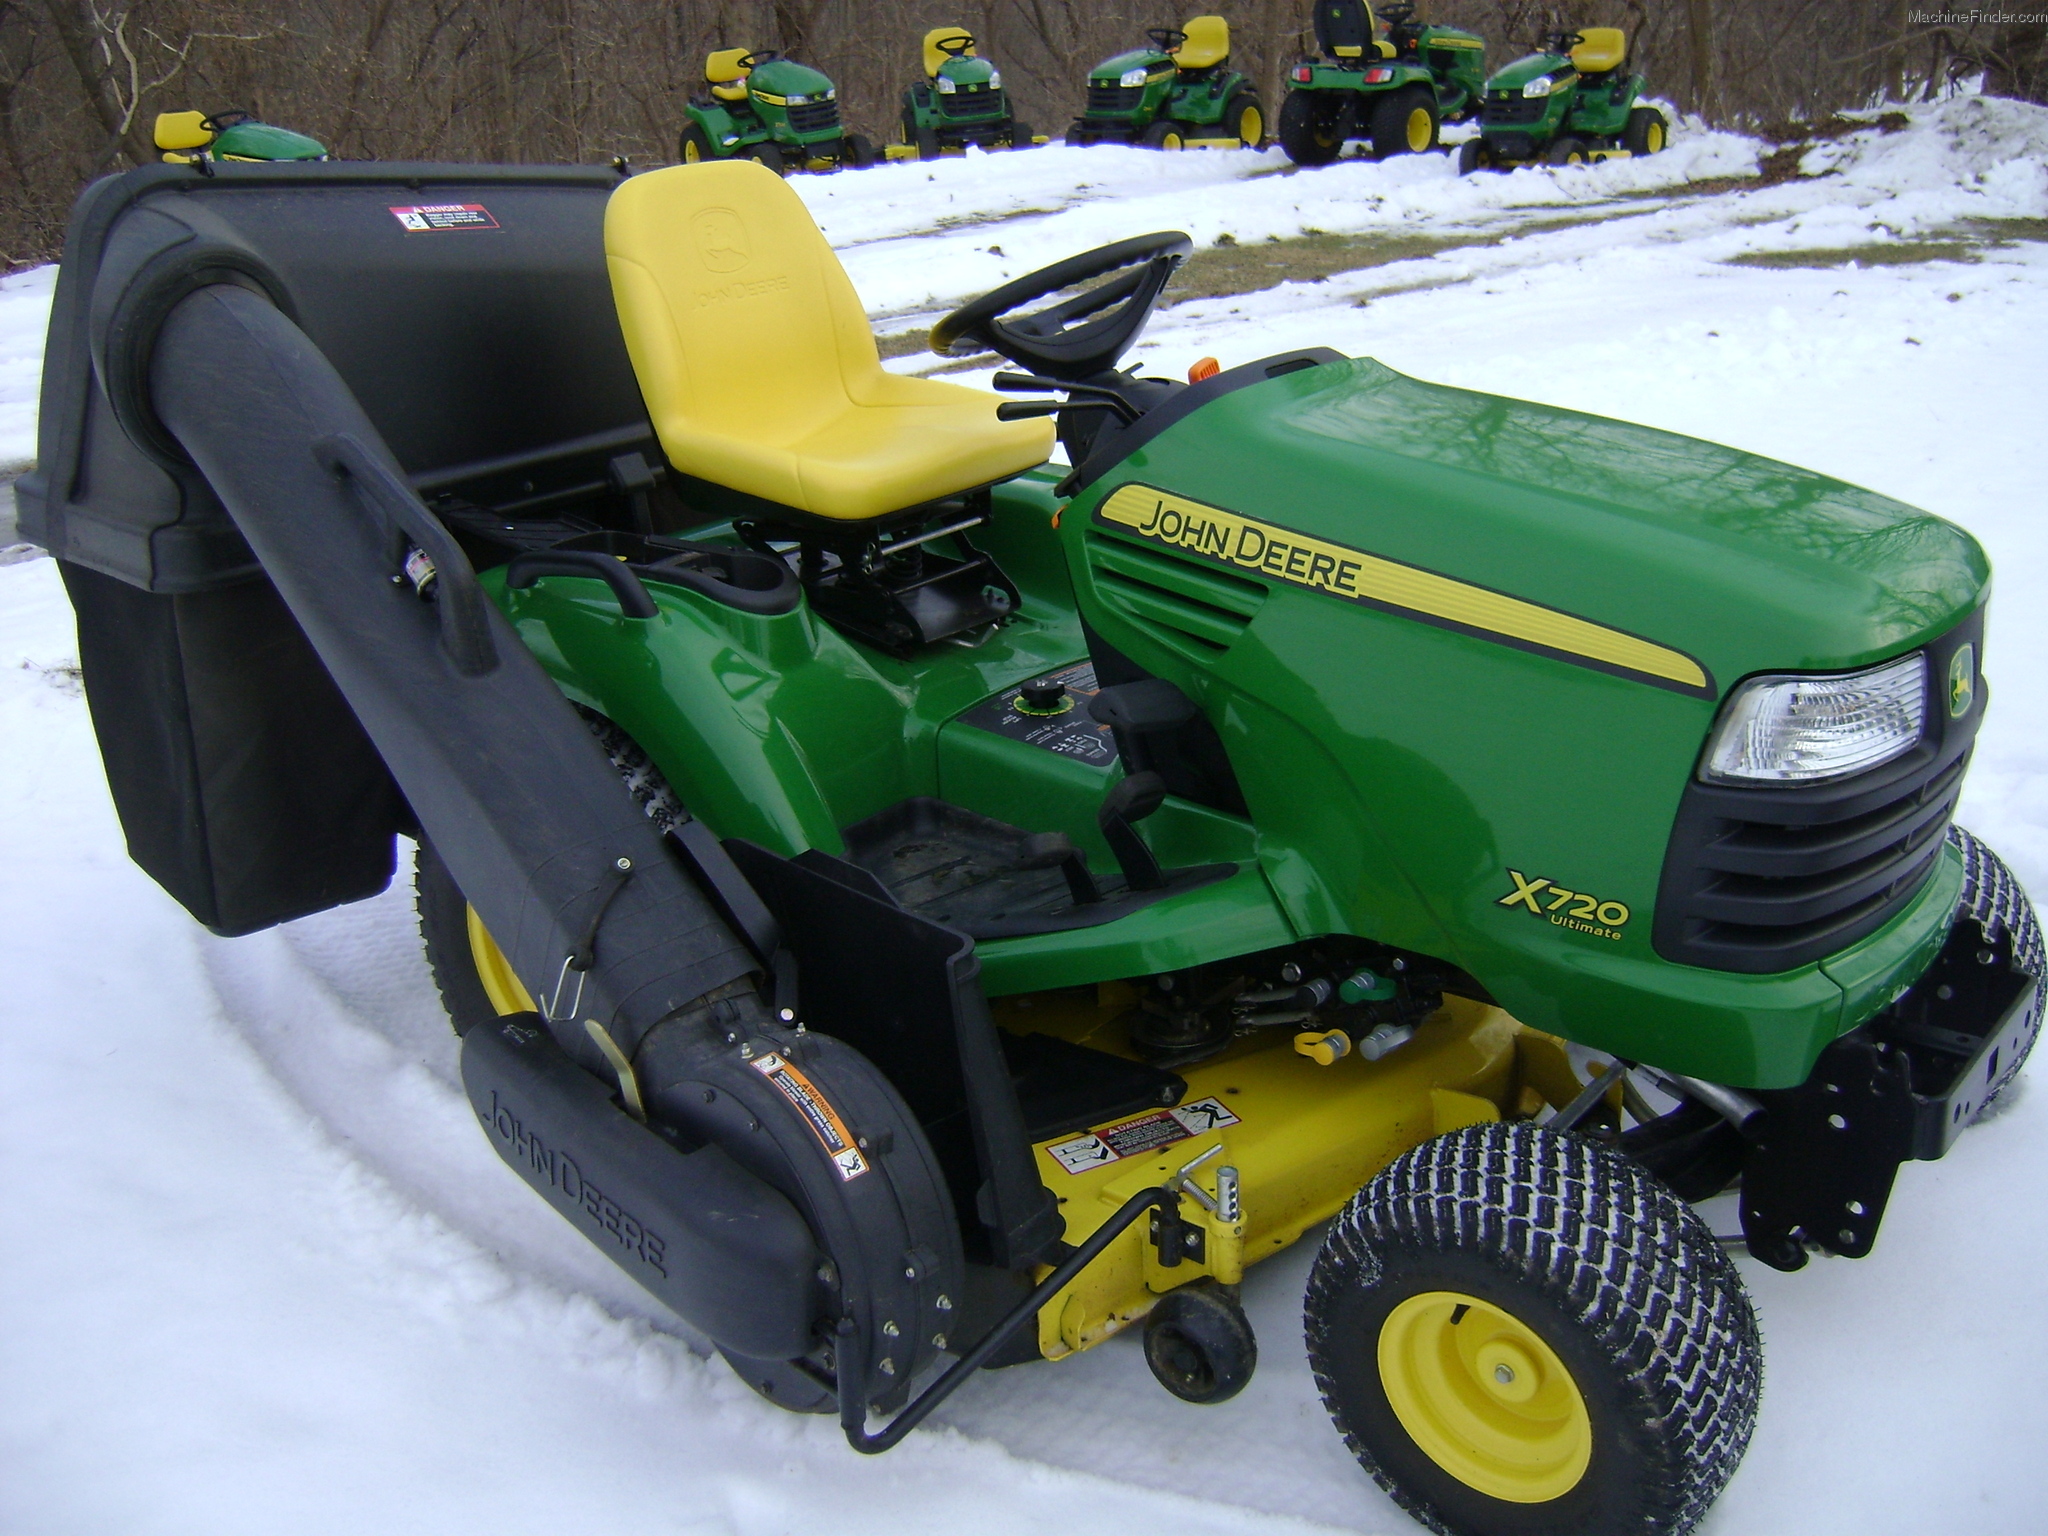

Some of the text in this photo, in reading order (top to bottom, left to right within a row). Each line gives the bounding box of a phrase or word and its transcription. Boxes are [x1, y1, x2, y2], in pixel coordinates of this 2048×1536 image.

[422, 205, 466, 213] DANGER
[732, 276, 790, 299] DEERE
[1139, 500, 1363, 594] JOHN DEERE
[1498, 869, 1630, 927] X720
[1550, 913, 1622, 941] Ultimate
[808, 1087, 835, 1120] WARNING
[1117, 1114, 1161, 1132] DANGER
[482, 1089, 668, 1279] JOHN DEERE
